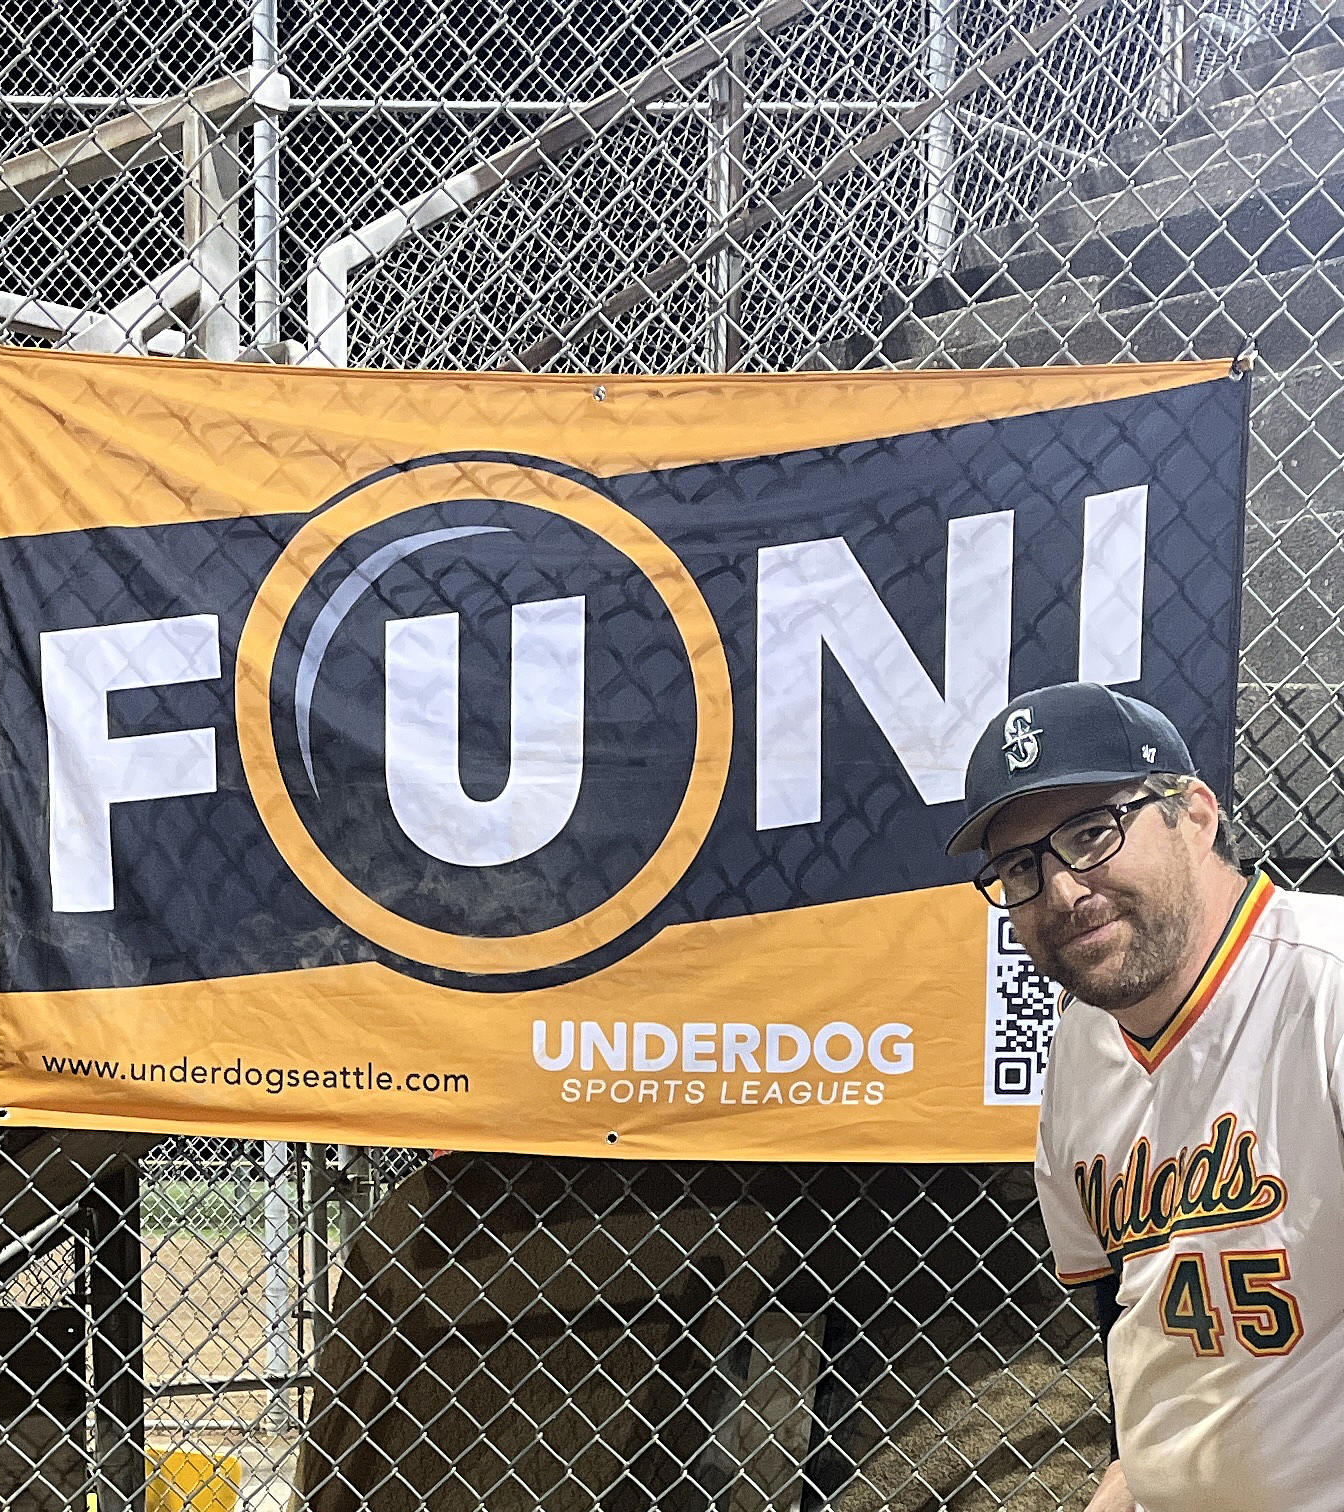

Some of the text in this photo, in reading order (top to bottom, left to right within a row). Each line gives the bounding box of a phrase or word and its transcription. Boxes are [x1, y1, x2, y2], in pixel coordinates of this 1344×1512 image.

[531, 1018, 915, 1075] UNDERDOG
[41, 1055, 471, 1094] www.underdogseattle.com
[560, 1078, 886, 1106] SPORTS LEAGUES
[1159, 1248, 1305, 1358] 45
